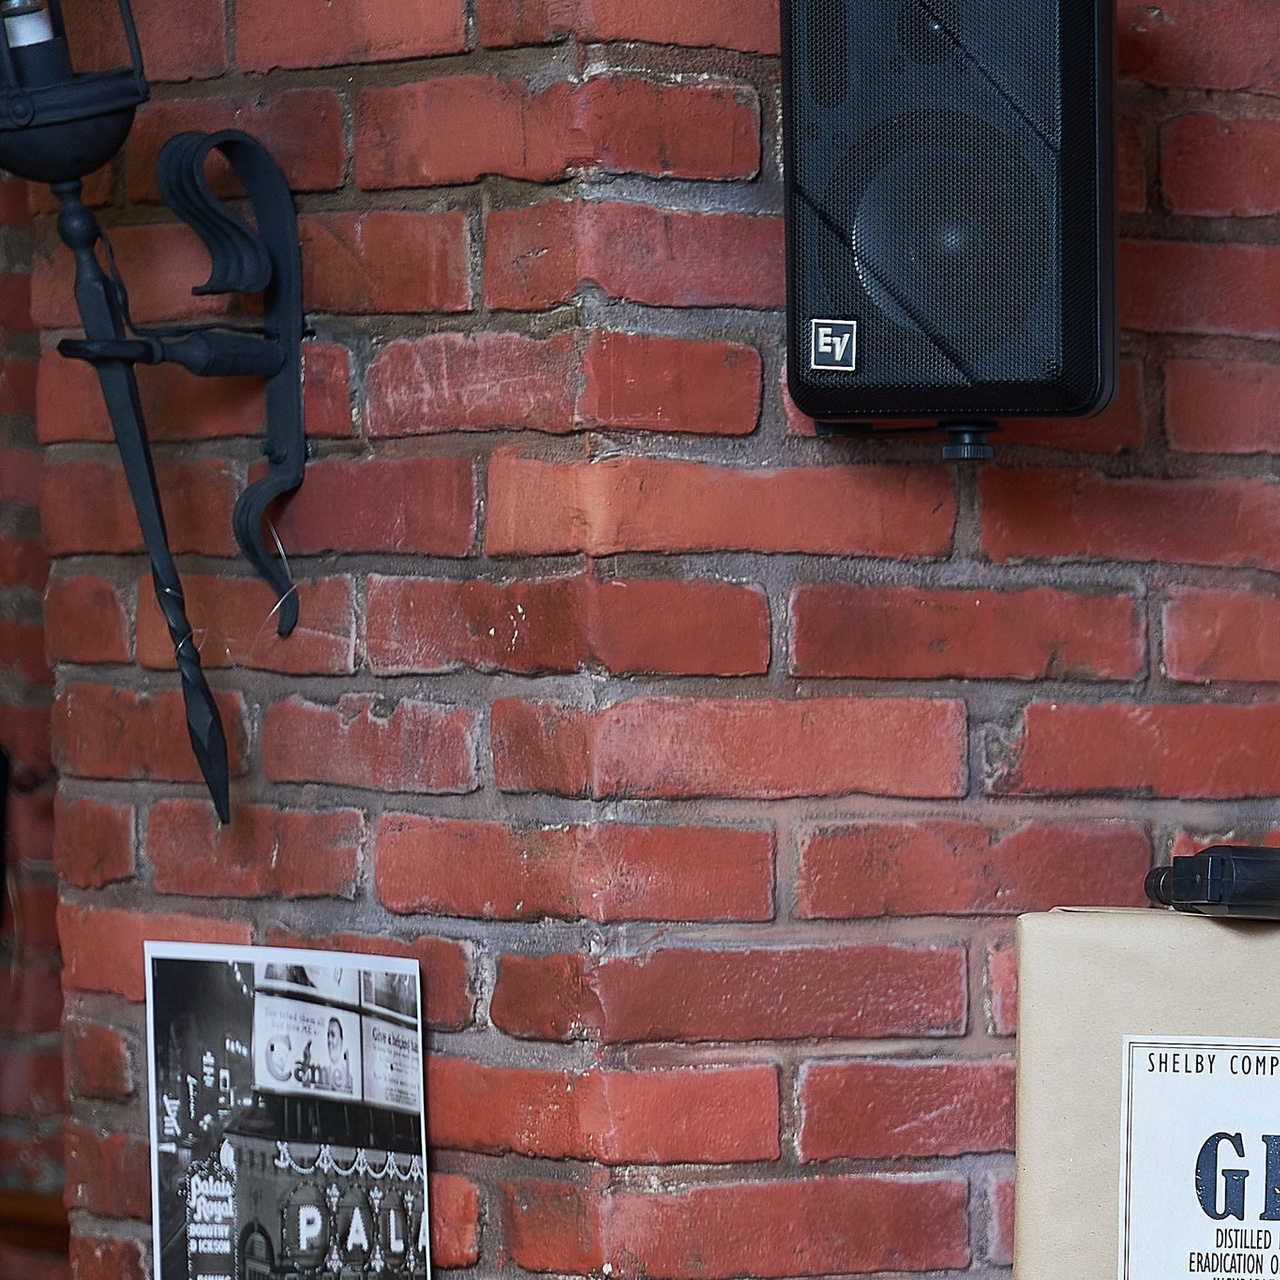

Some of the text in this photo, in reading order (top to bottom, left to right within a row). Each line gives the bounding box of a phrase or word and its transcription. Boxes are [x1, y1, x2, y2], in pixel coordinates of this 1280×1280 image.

[1148, 1053, 1216, 1075] SHELBY
[191, 1173, 232, 1208] Palais
[194, 1195, 234, 1222] Royal
[1216, 1229, 1272, 1250] DISTILLED
[1189, 1252, 1265, 1274] ERADICATION
